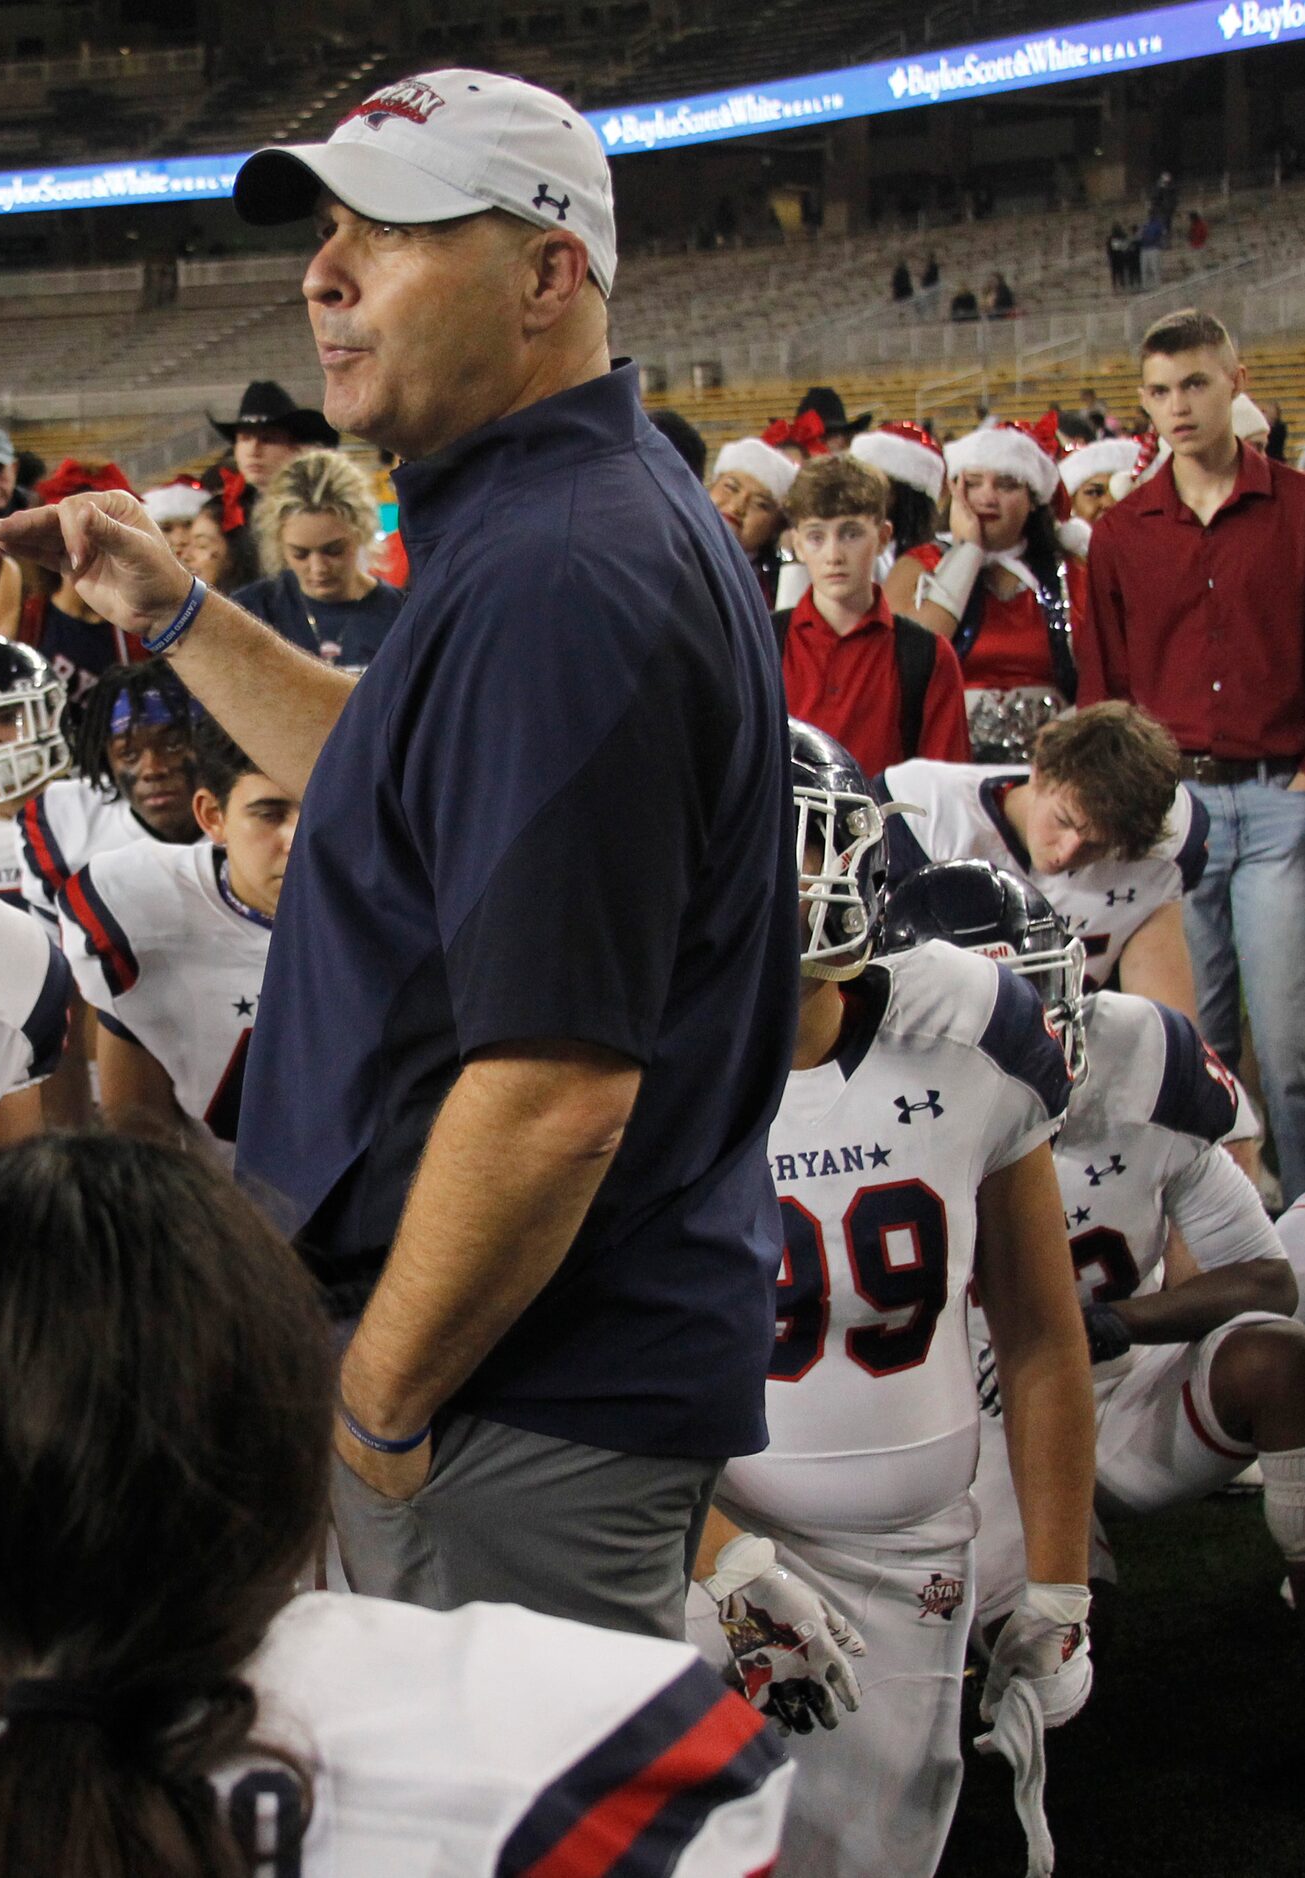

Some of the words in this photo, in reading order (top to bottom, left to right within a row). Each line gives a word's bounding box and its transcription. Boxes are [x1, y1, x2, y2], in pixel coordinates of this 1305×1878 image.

[1089, 37, 1163, 65] HEALTH
[782, 93, 844, 117] HEALTH
[171, 174, 233, 194] HEALT
[775, 1144, 865, 1182] RYAN
